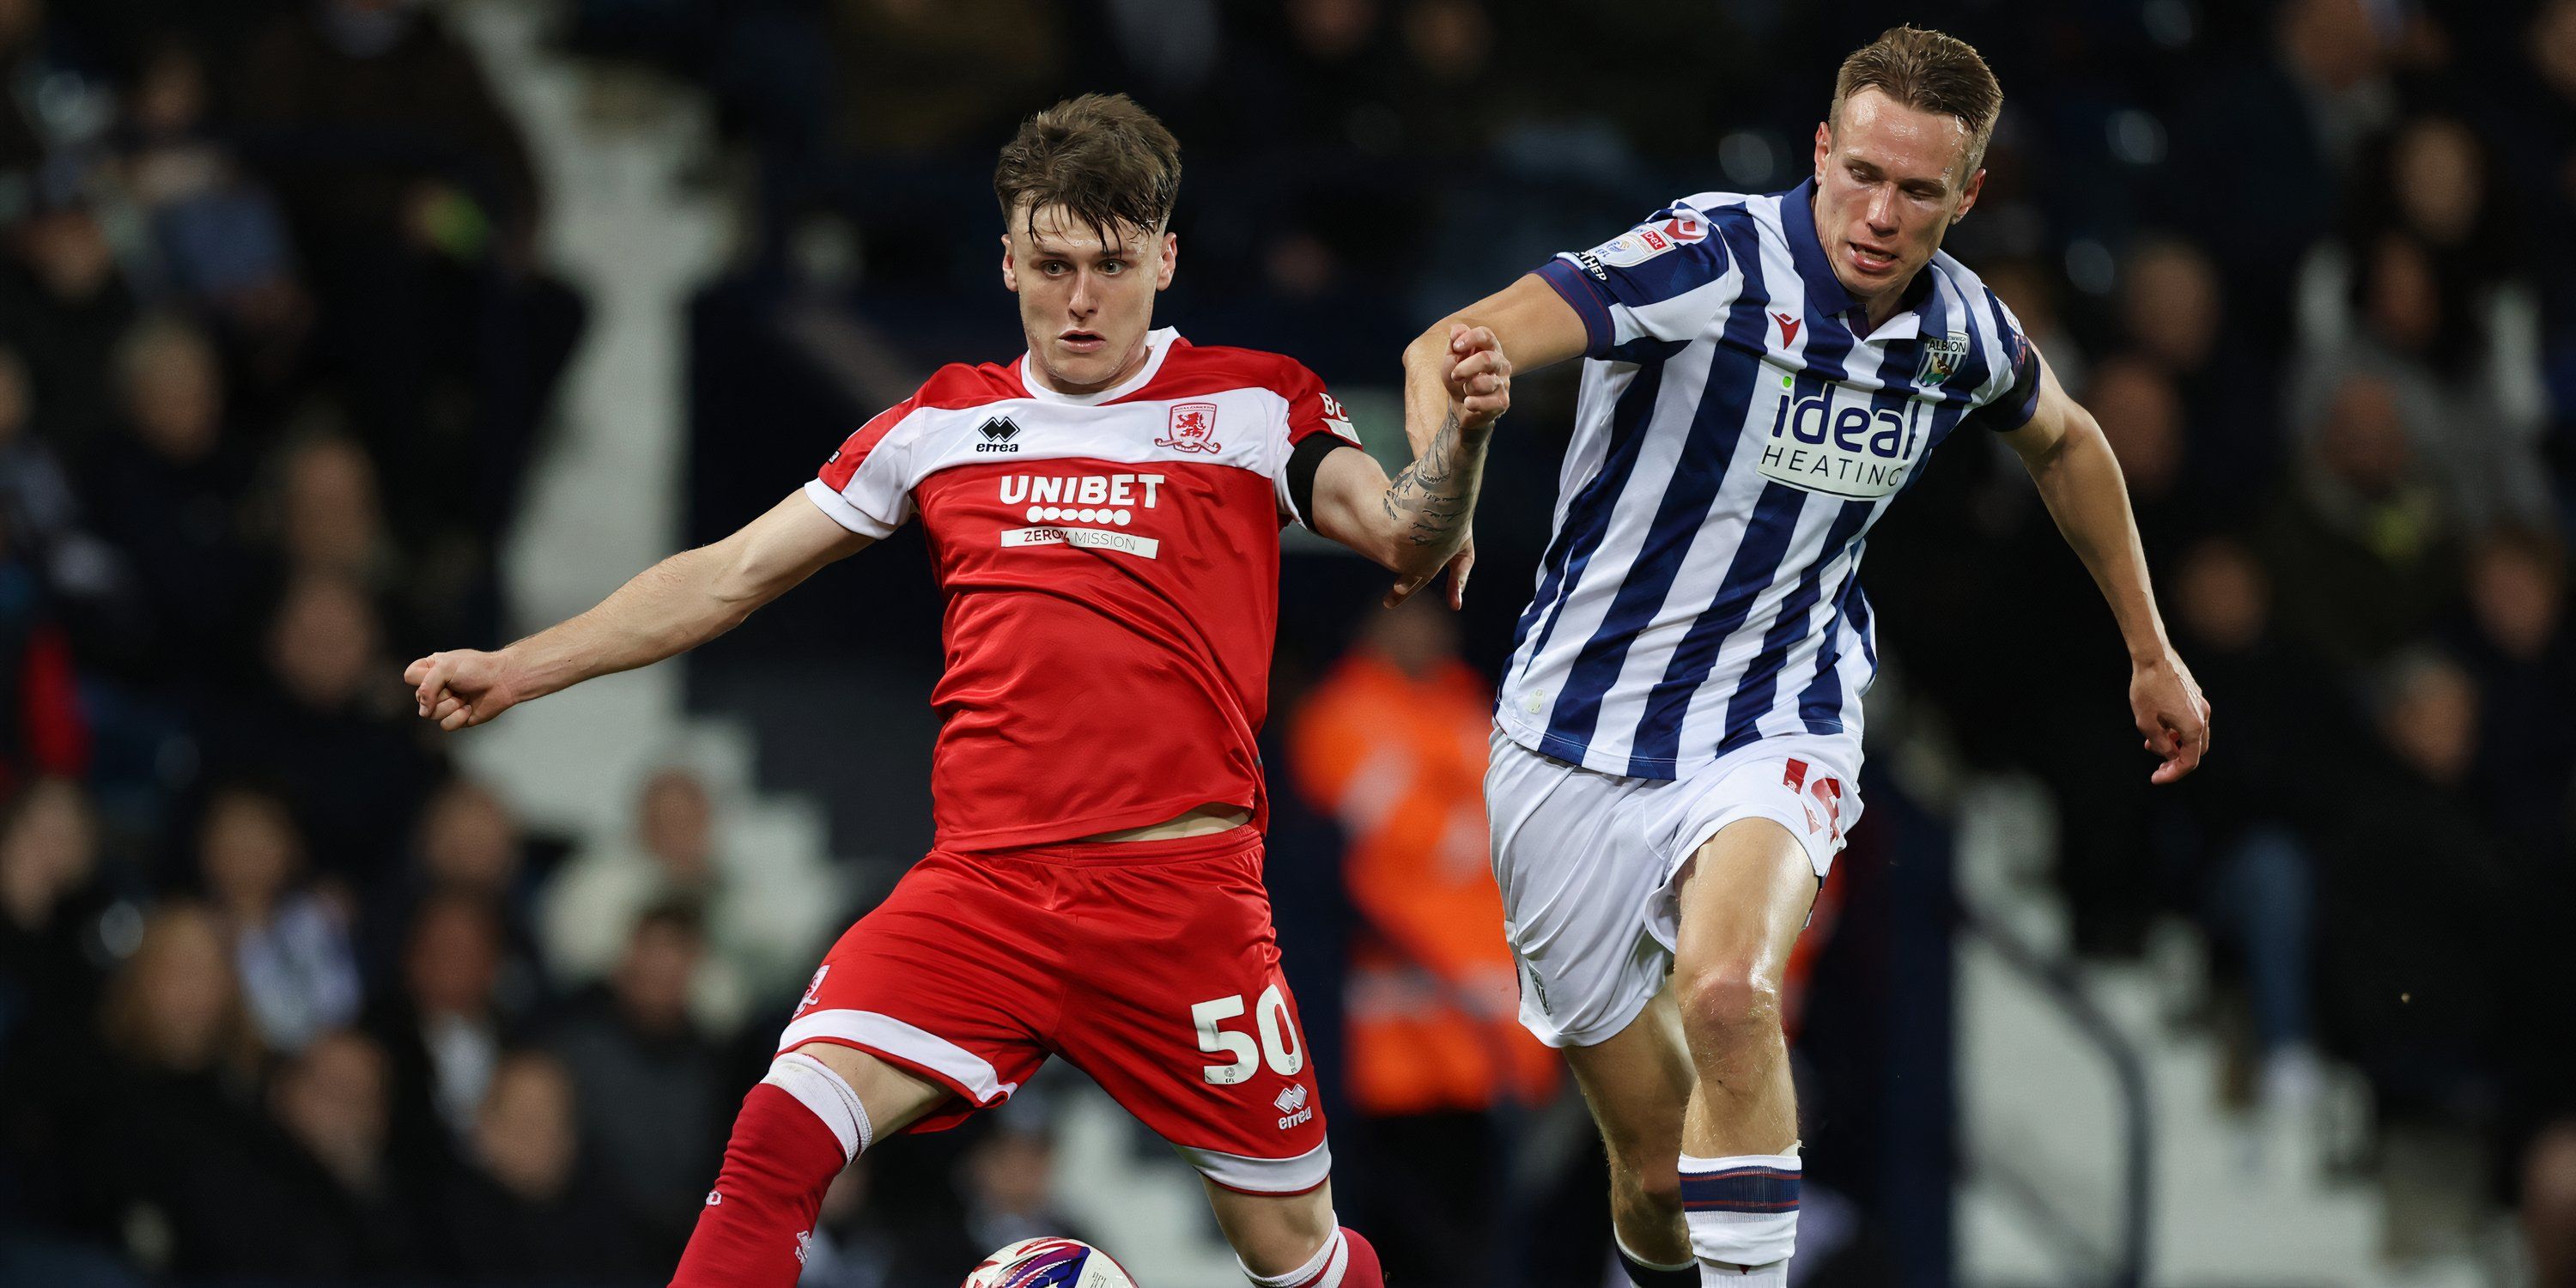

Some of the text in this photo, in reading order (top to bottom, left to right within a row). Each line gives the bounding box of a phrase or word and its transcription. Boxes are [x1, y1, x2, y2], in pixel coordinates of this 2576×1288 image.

[1644, 231, 1663, 249] bet
[1928, 340, 1966, 353] ALBION
[1772, 375, 1923, 460] ideal
[976, 443, 1018, 453] errea
[1761, 445, 1904, 487] HEATING
[999, 474, 1165, 508] UNIBET
[1074, 532, 1136, 550] MISSION
[1191, 983, 1303, 1084] 50
[1278, 1106, 1312, 1130] errea
